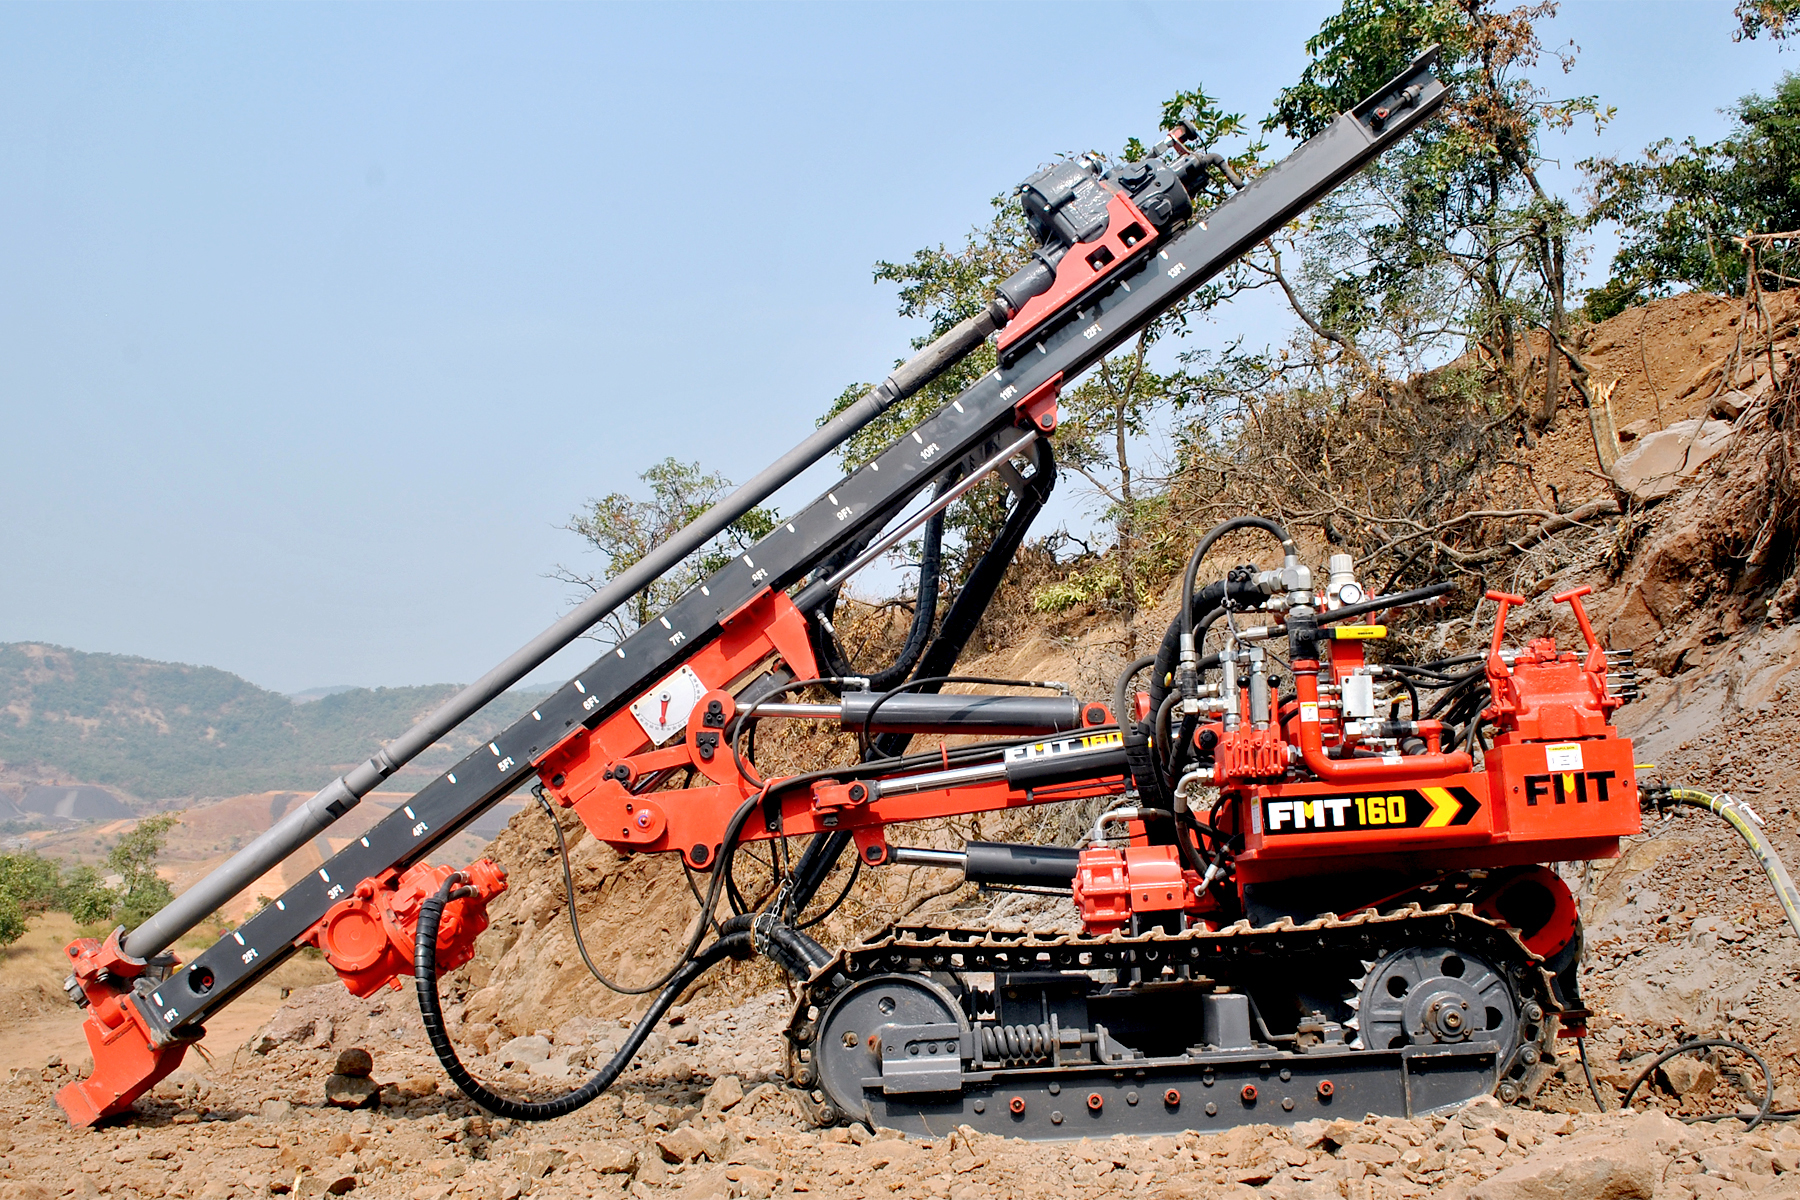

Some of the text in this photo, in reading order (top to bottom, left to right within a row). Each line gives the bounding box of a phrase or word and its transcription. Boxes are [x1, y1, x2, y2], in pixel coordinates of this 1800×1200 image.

[1167, 261, 1187, 279] 13Ft
[1083, 323, 1103, 340] 12Ft
[999, 384, 1018, 401] 11Ft
[919, 442, 940, 461] 10Ft
[836, 505, 854, 522] 9Ft
[751, 567, 769, 582] 8Ft
[668, 630, 686, 647] 7Ft
[582, 694, 600, 711] 6Ft
[497, 756, 515, 773] 5Ft
[1524, 770, 1616, 806] FMT
[1268, 798, 1352, 830] FMT
[1355, 796, 1406, 825] 160
[412, 821, 429, 837] 4Ft
[327, 883, 345, 900] 3Ft
[241, 947, 259, 965] 2Ft
[163, 1007, 179, 1023] 1Ft
